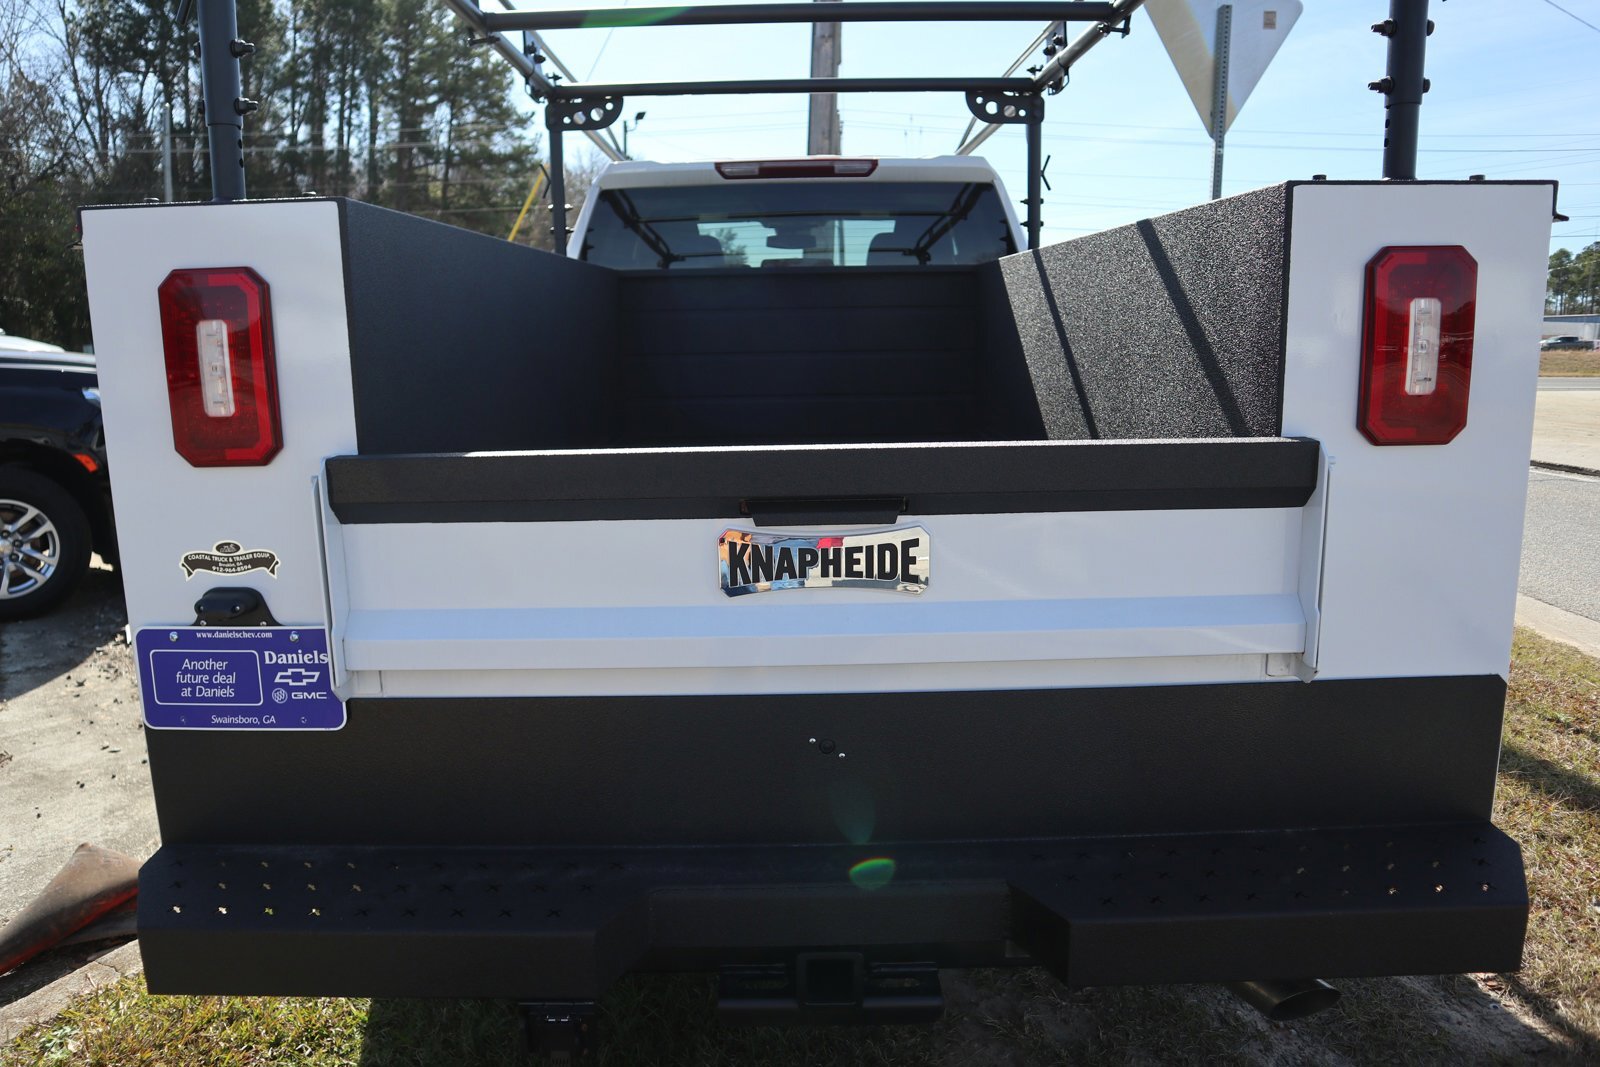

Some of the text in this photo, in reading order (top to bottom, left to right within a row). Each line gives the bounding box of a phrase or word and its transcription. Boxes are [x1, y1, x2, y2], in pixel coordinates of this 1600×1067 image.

[233, 554, 253, 562] TRAILER
[728, 537, 920, 587] KNAPHEIDE
[196, 631, 273, 639] www.danielschev.com
[264, 649, 329, 665] Daniels
[181, 658, 229, 671] Another
[176, 672, 236, 684] future deal
[181, 685, 235, 698] at Daniels
[291, 691, 328, 700] GMC
[211, 714, 276, 725] Swainsboro, GA
